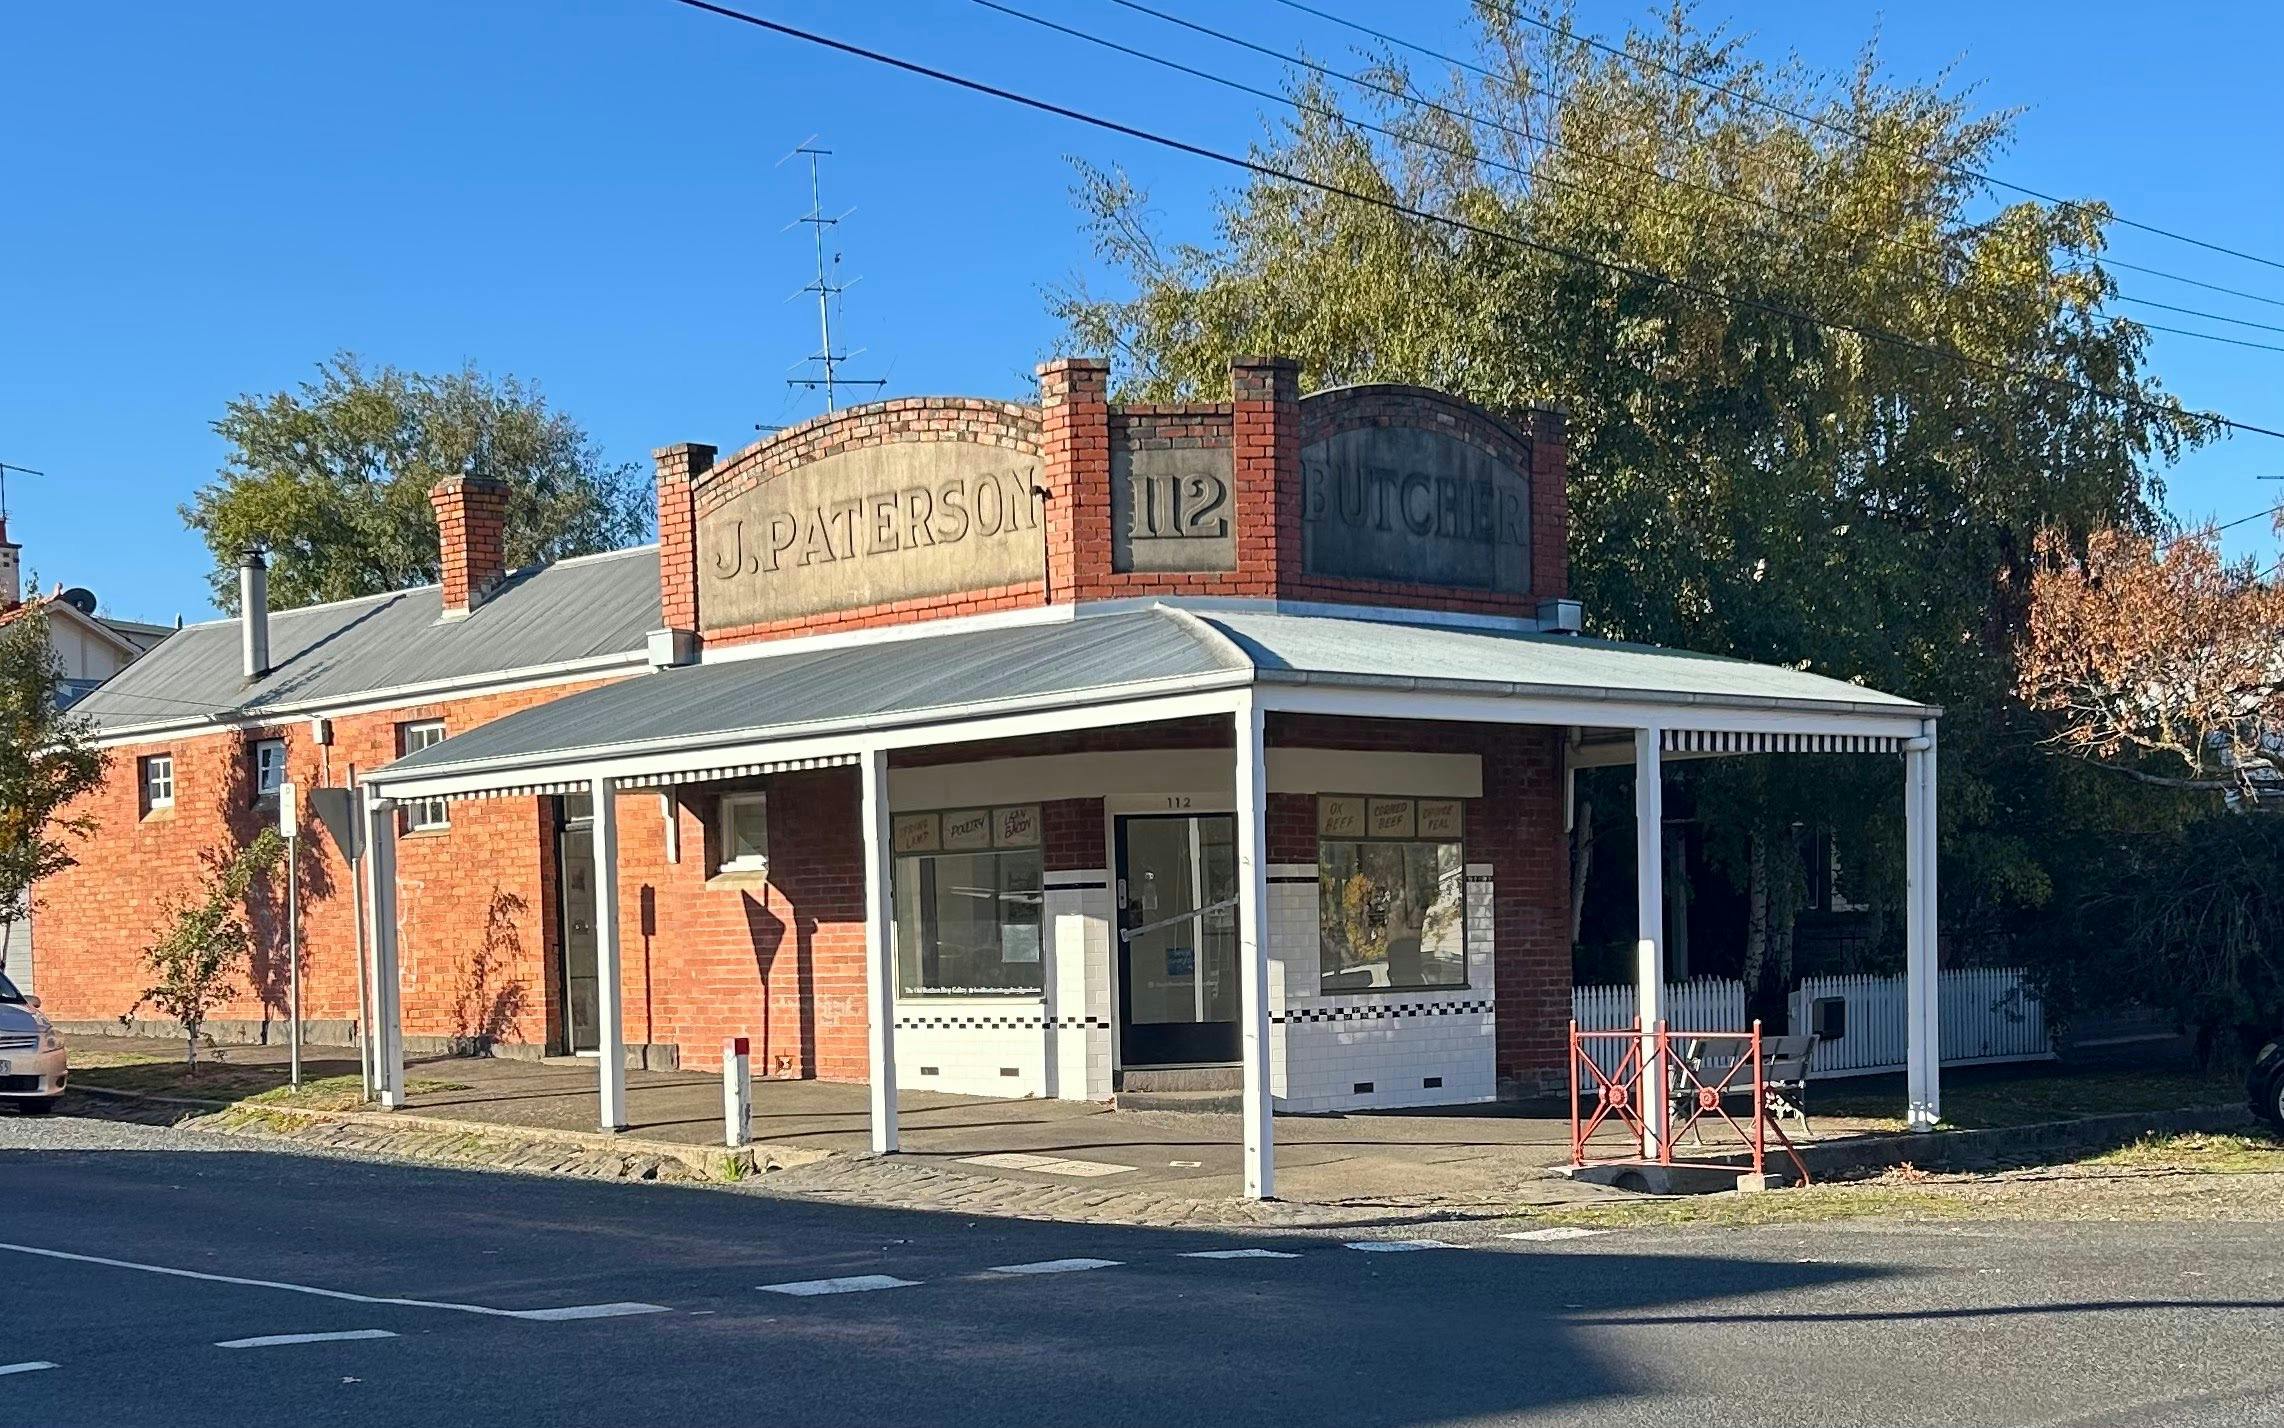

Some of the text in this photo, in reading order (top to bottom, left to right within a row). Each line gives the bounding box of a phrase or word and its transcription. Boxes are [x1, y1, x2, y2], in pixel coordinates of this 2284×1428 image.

[1127, 472, 1228, 540] 112
[1300, 459, 1530, 547] BUTCHER
[1167, 797, 1192, 809] 112
[1329, 802, 1343, 816] OX
[1325, 816, 1354, 832] BEEF
[1378, 815, 1403, 830] BEEF
